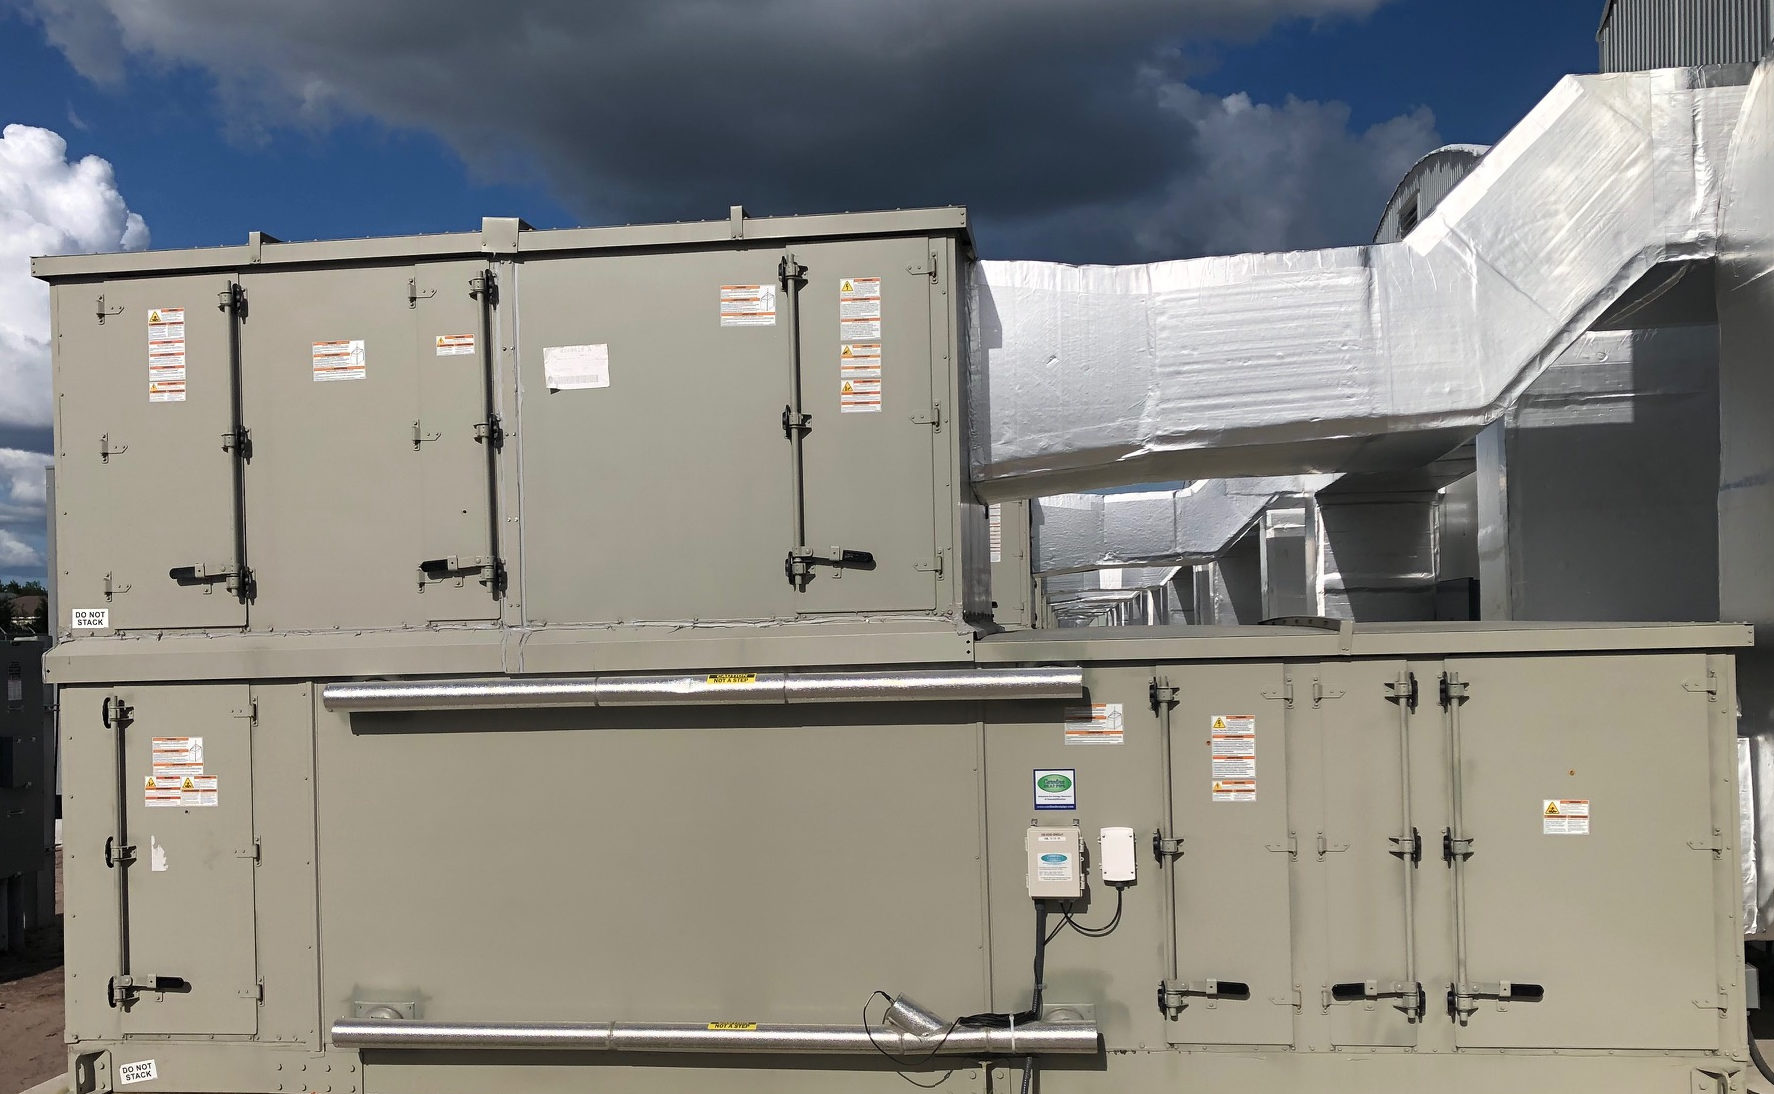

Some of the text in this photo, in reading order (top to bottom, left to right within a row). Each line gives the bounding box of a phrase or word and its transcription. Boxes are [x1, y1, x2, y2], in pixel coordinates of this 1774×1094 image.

[122, 1062, 152, 1074] DO NOT
[125, 1070, 152, 1081] STACK
